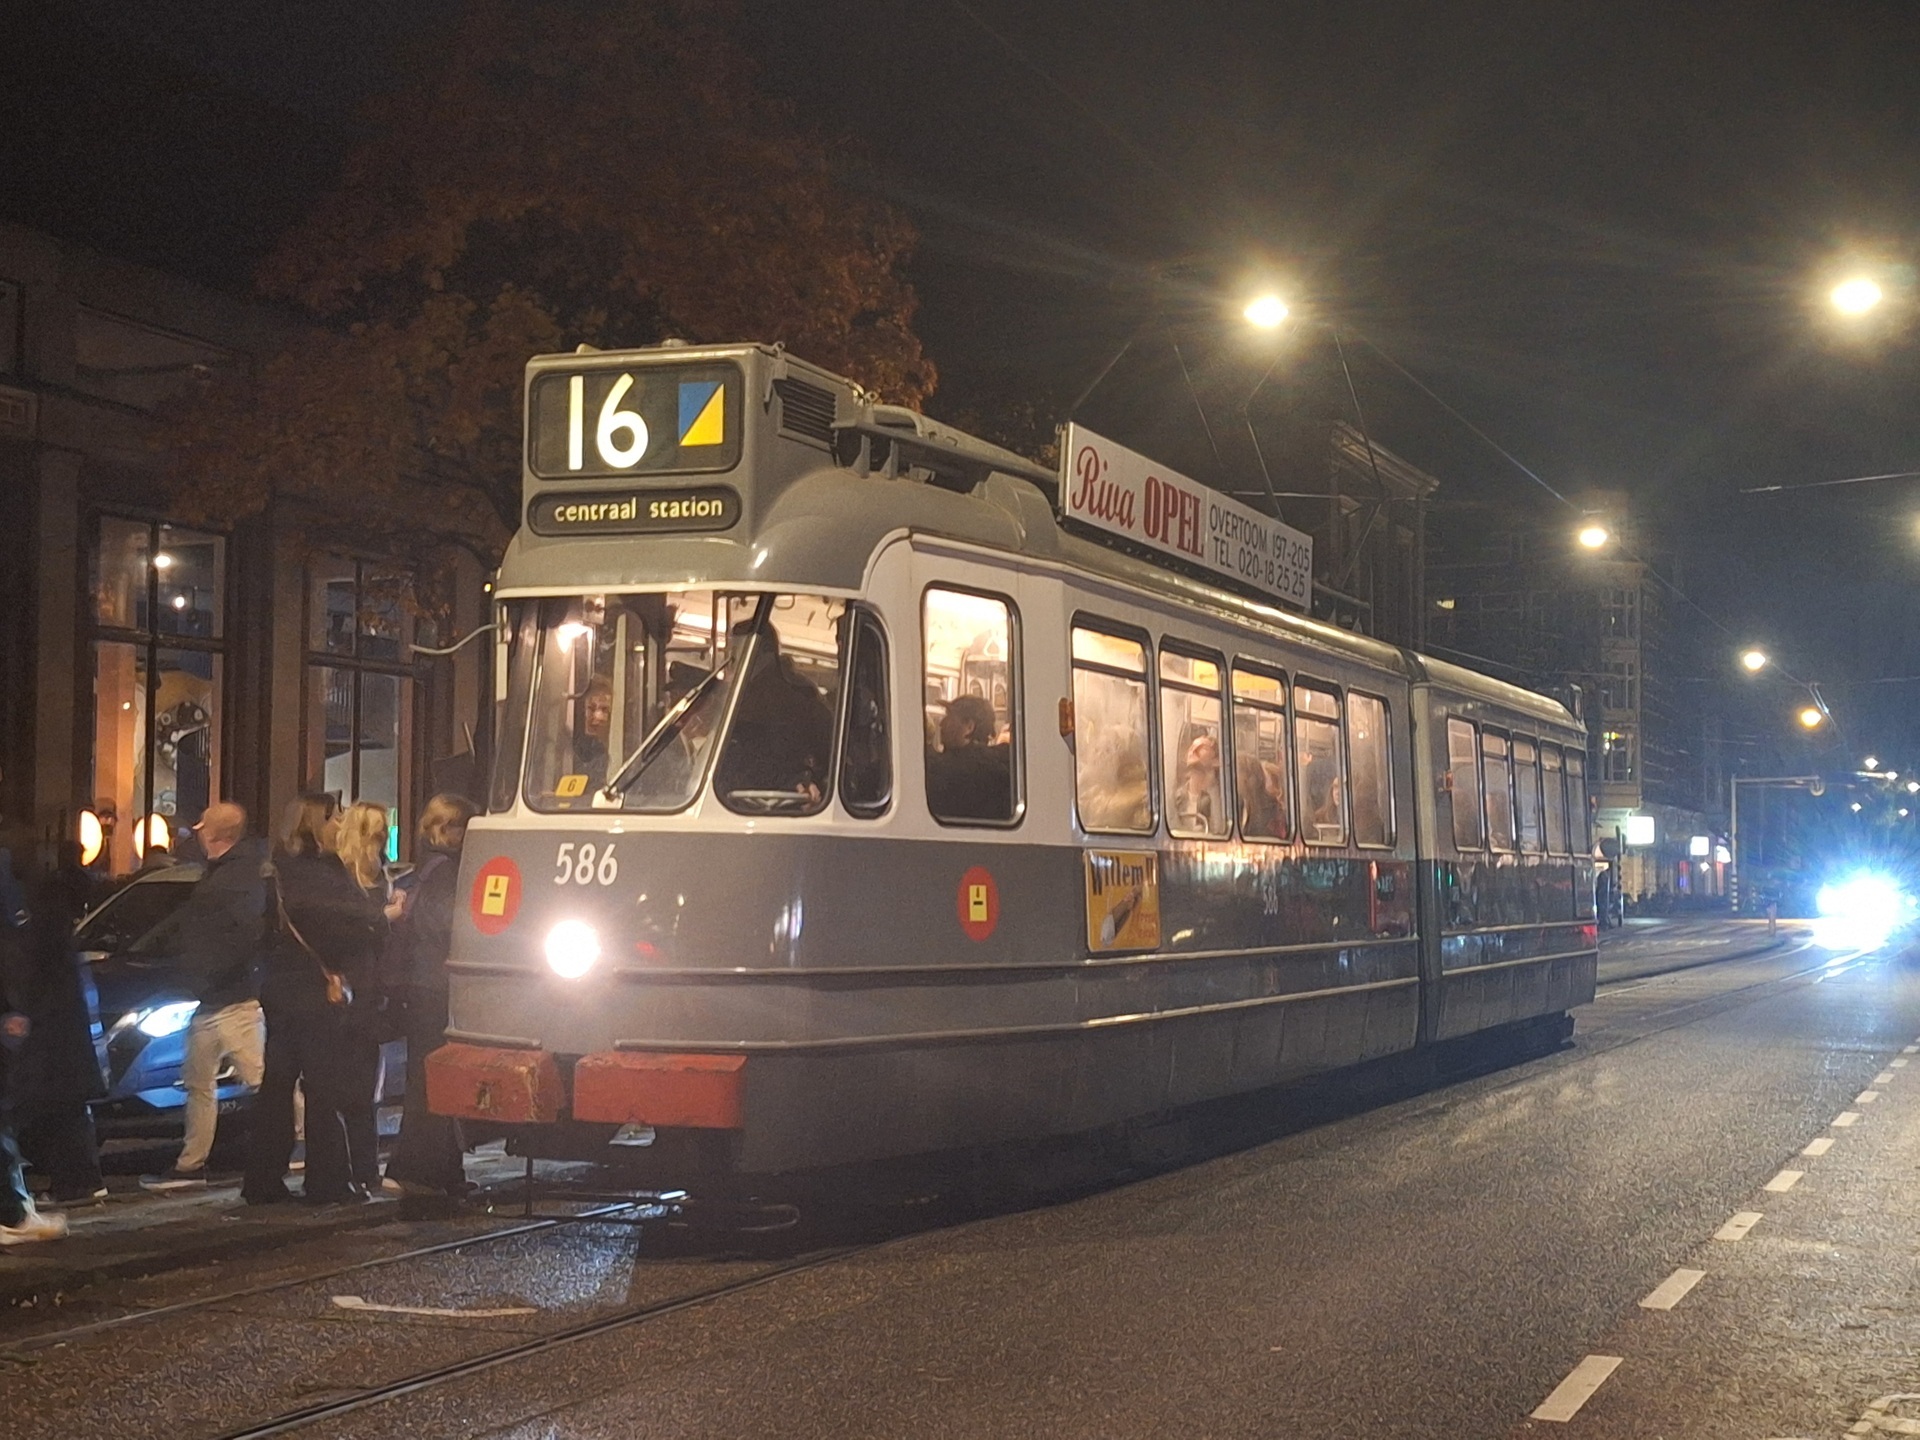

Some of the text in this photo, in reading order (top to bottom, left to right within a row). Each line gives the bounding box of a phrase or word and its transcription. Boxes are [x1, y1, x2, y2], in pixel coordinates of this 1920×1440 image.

[568, 372, 649, 471] 16
[554, 495, 723, 522] centraal station
[1072, 446, 1204, 558] Riva OPEL
[1209, 503, 1311, 573] OVERTOOM 197-205
[554, 842, 618, 886] 586
